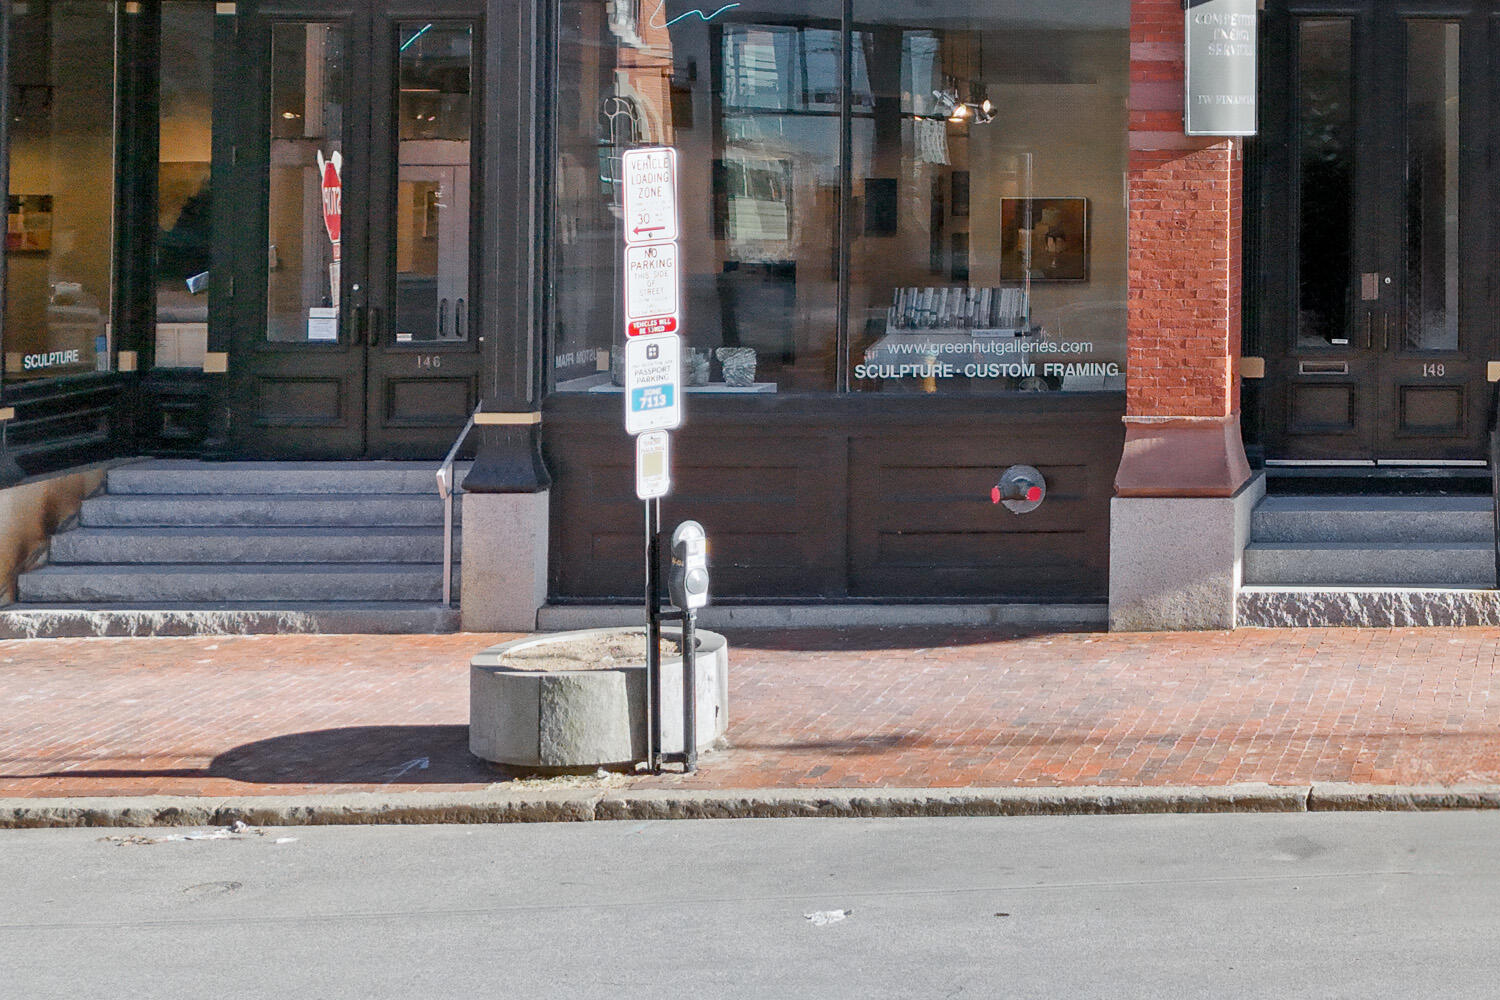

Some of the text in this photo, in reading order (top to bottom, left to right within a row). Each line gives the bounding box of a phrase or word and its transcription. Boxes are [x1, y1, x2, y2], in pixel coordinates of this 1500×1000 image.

[631, 157, 669, 170] VEHICLE
[631, 172, 669, 185] LOADING
[638, 186, 662, 199] ZONE
[637, 213, 650, 225] 30
[644, 247, 658, 259] NO
[631, 258, 672, 271] PARKING
[634, 269, 668, 281] THIS SIDE
[640, 287, 664, 297] STREET
[887, 339, 1093, 356] www.greenhutgalleries.com
[24, 349, 79, 369] SCULPTURE
[417, 355, 441, 369] 146
[634, 365, 670, 377] PASSPORT
[854, 362, 1119, 379] SCULPTURE CUSTOM FRAMING
[1422, 363, 1445, 378] 148
[637, 374, 669, 385] PARKING
